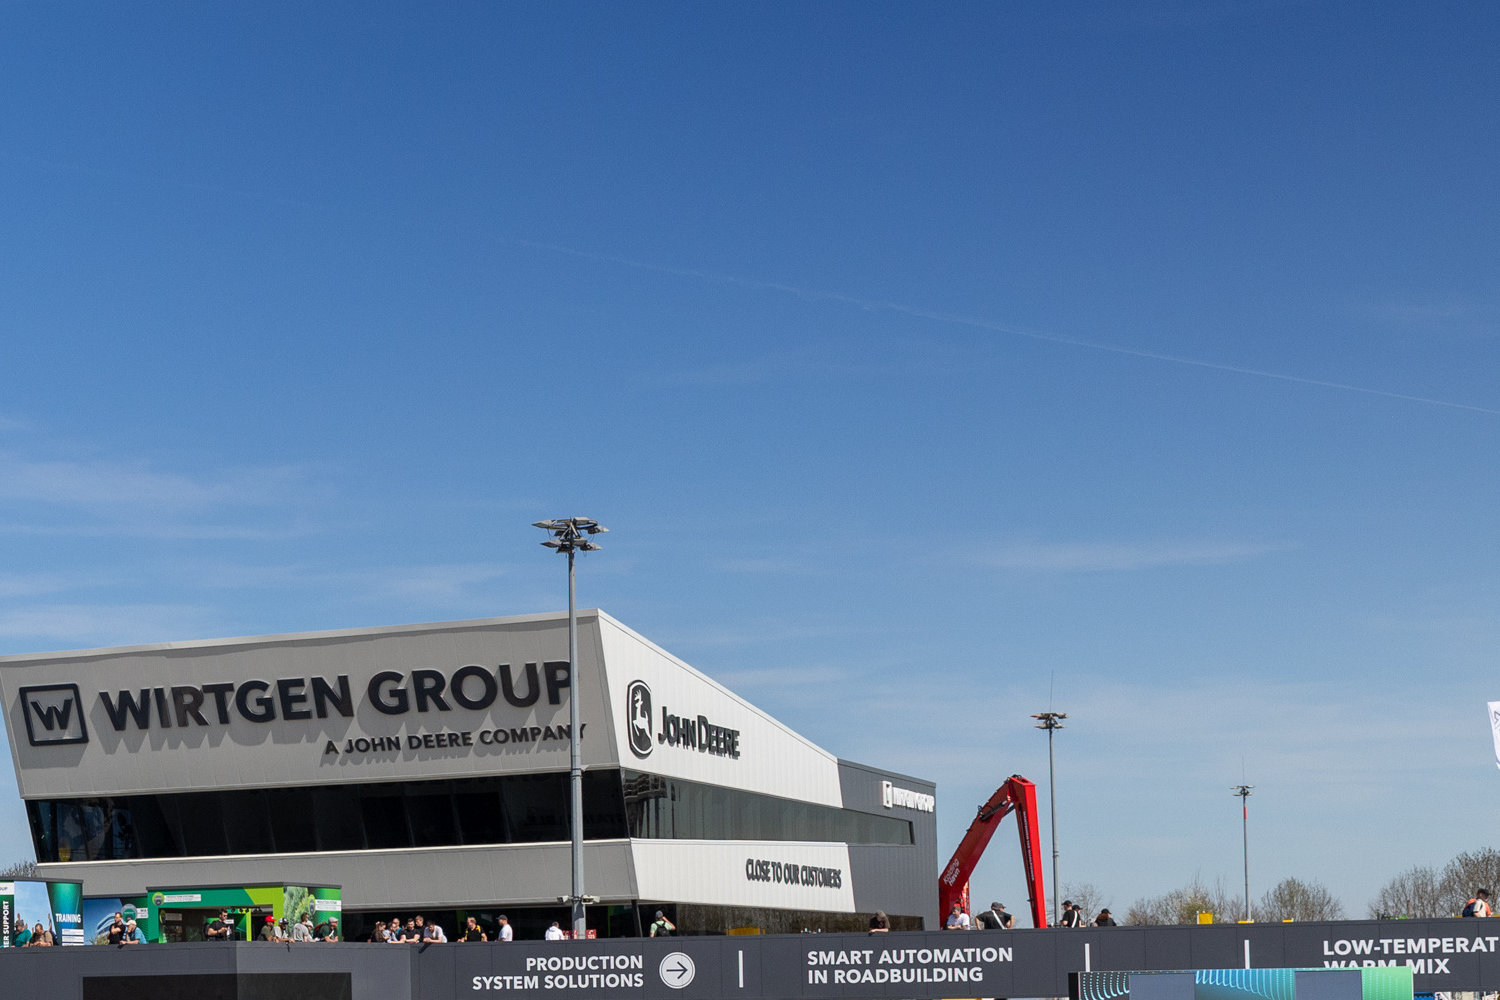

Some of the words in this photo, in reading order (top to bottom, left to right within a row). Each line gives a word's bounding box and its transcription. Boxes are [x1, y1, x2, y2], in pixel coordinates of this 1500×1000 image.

[99, 675, 355, 731] WIRTGEN
[368, 660, 572, 715] GROUP
[325, 740, 339, 755] A
[345, 735, 401, 755] JOHN
[408, 731, 473, 750] DEERE
[479, 723, 587, 746] COMPANY
[658, 706, 696, 748] JOHN
[697, 715, 740, 759] DEERE
[746, 858, 770, 882] CLOSE
[771, 861, 782, 884] TO
[783, 863, 799, 885] OUR
[800, 865, 842, 889] CUSTOMERS
[55, 913, 81, 923] TRAINING
[1323, 936, 1499, 956] LOW-TEMPERAT
[526, 955, 643, 971] PRODUCTION
[807, 950, 873, 966] SMART
[878, 947, 1013, 964] AUTOMATION
[1406, 958, 1450, 974] MIX
[472, 975, 539, 990] SYSTEM
[544, 973, 644, 989] SOLUTIONS
[808, 969, 828, 984] IN
[834, 966, 983, 984] ROADBUILDING
